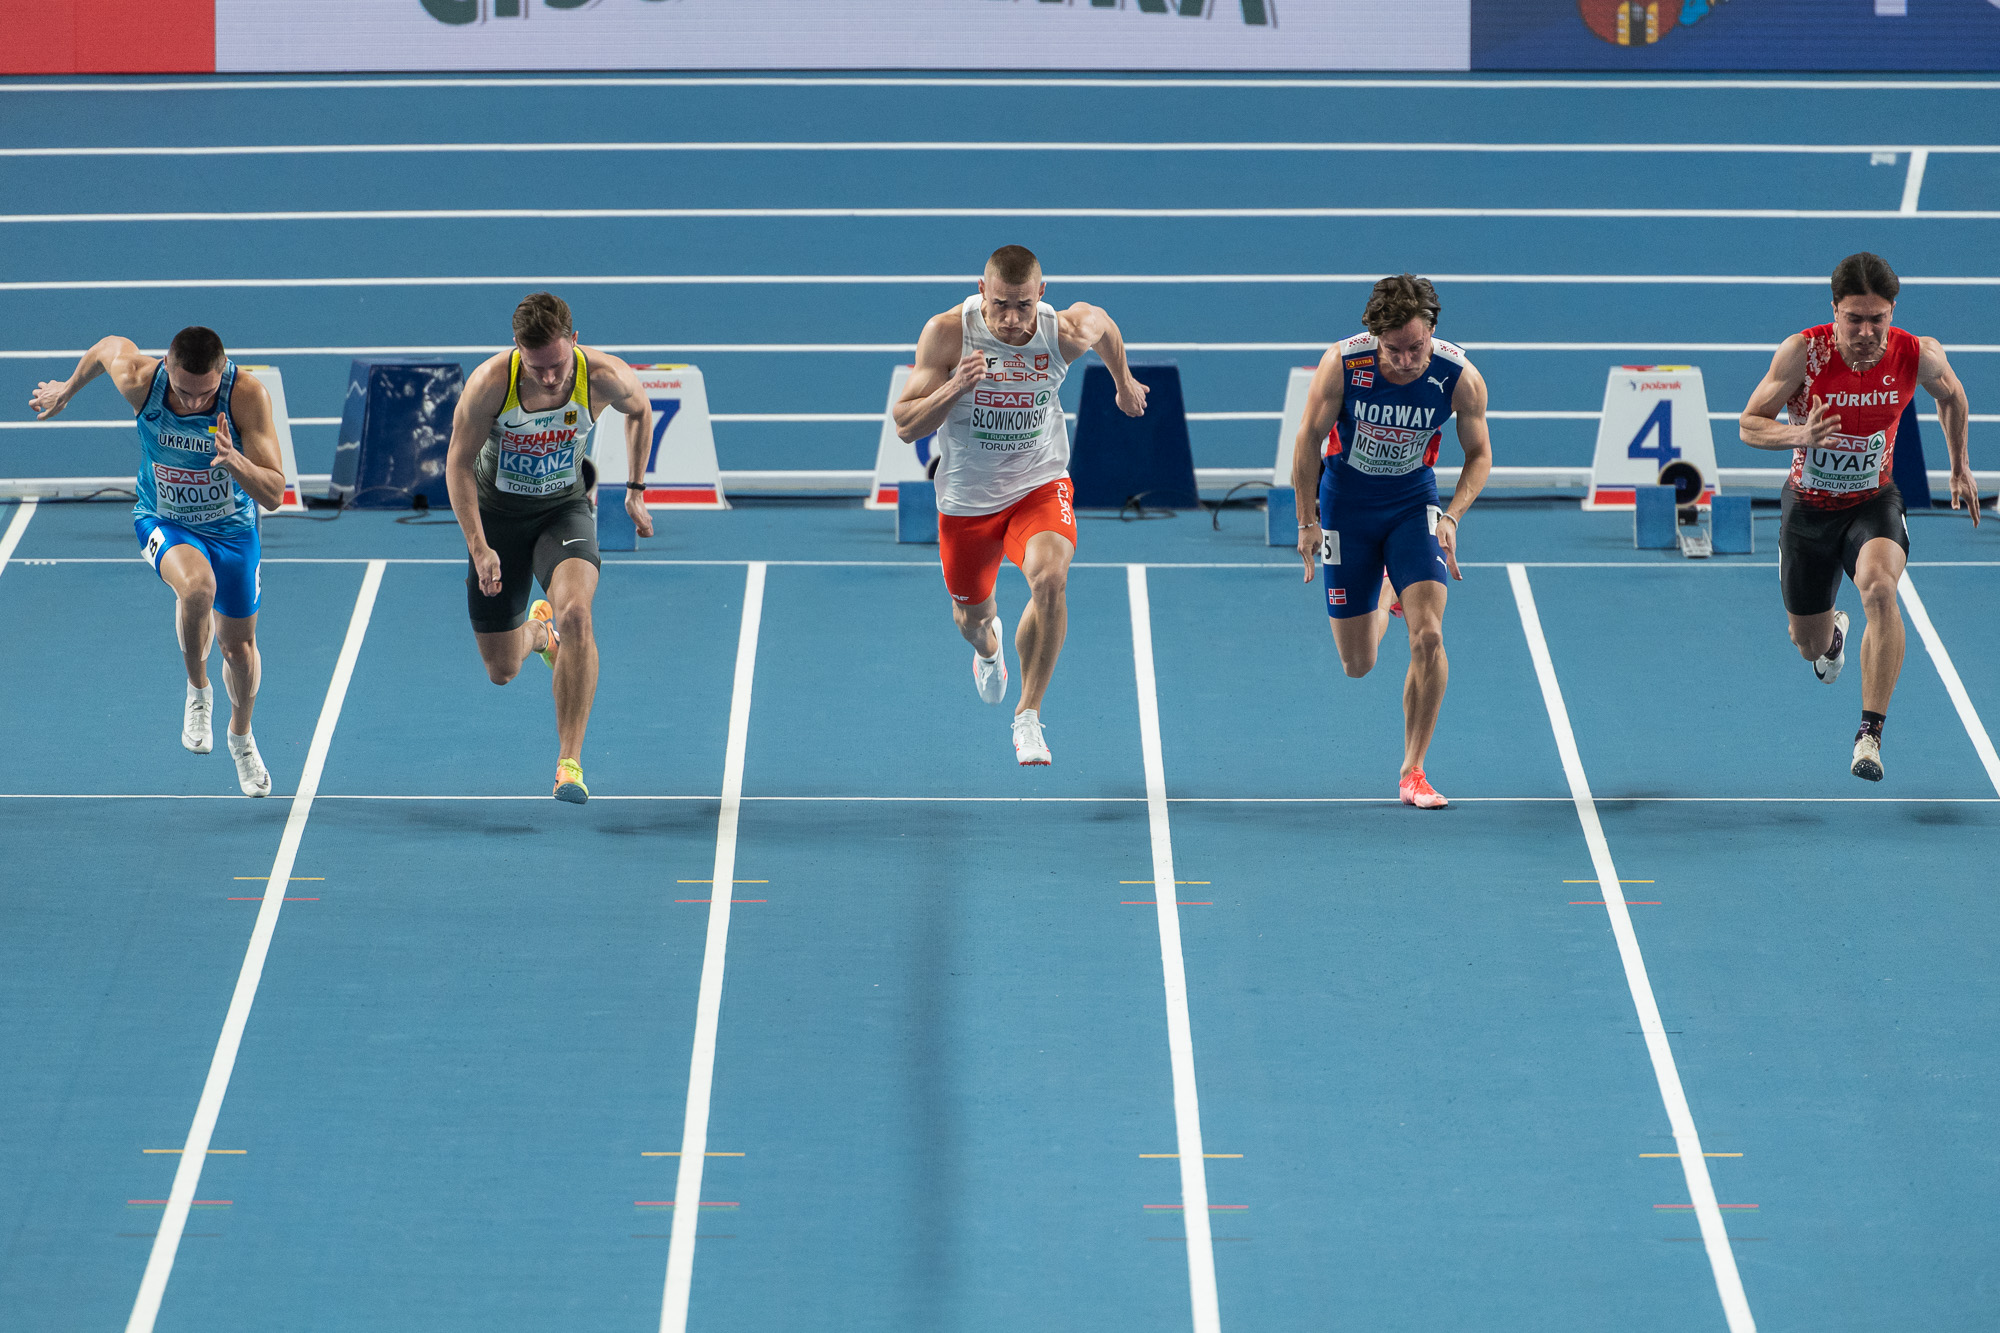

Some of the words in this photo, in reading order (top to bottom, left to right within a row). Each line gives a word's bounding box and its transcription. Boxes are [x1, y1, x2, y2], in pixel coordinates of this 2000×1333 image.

[985, 372, 1049, 382] POLSKA
[1641, 380, 1682, 392] polanik
[976, 391, 1034, 406] SPAR
[1825, 389, 1900, 407] TÜRKİYE
[972, 407, 1047, 431] SŁOWIKOWSKI
[1354, 400, 1436, 428] NORWAY
[504, 428, 578, 445] GERMANY
[646, 398, 682, 473] 7
[1359, 422, 1415, 442] SPAR
[1627, 398, 1682, 473] 4
[159, 434, 212, 453] UKRAINE
[503, 442, 557, 454] SPAR
[980, 441, 1016, 452] TORUŃ
[1018, 440, 1037, 450] 2021
[1355, 434, 1427, 459] MEINSETH
[503, 449, 572, 476] KRANZ
[1395, 462, 1415, 474] 2021
[1812, 448, 1878, 472] UYAR
[156, 467, 209, 483] SPAR
[518, 475, 534, 484] RUN
[535, 474, 557, 485] CLEAN
[158, 481, 229, 504] SOKOLOV
[544, 480, 567, 493] 2021
[1849, 480, 1870, 490] 2021
[204, 508, 227, 521] 2021
[149, 537, 158, 558] 8
[1324, 535, 1332, 560] 5
